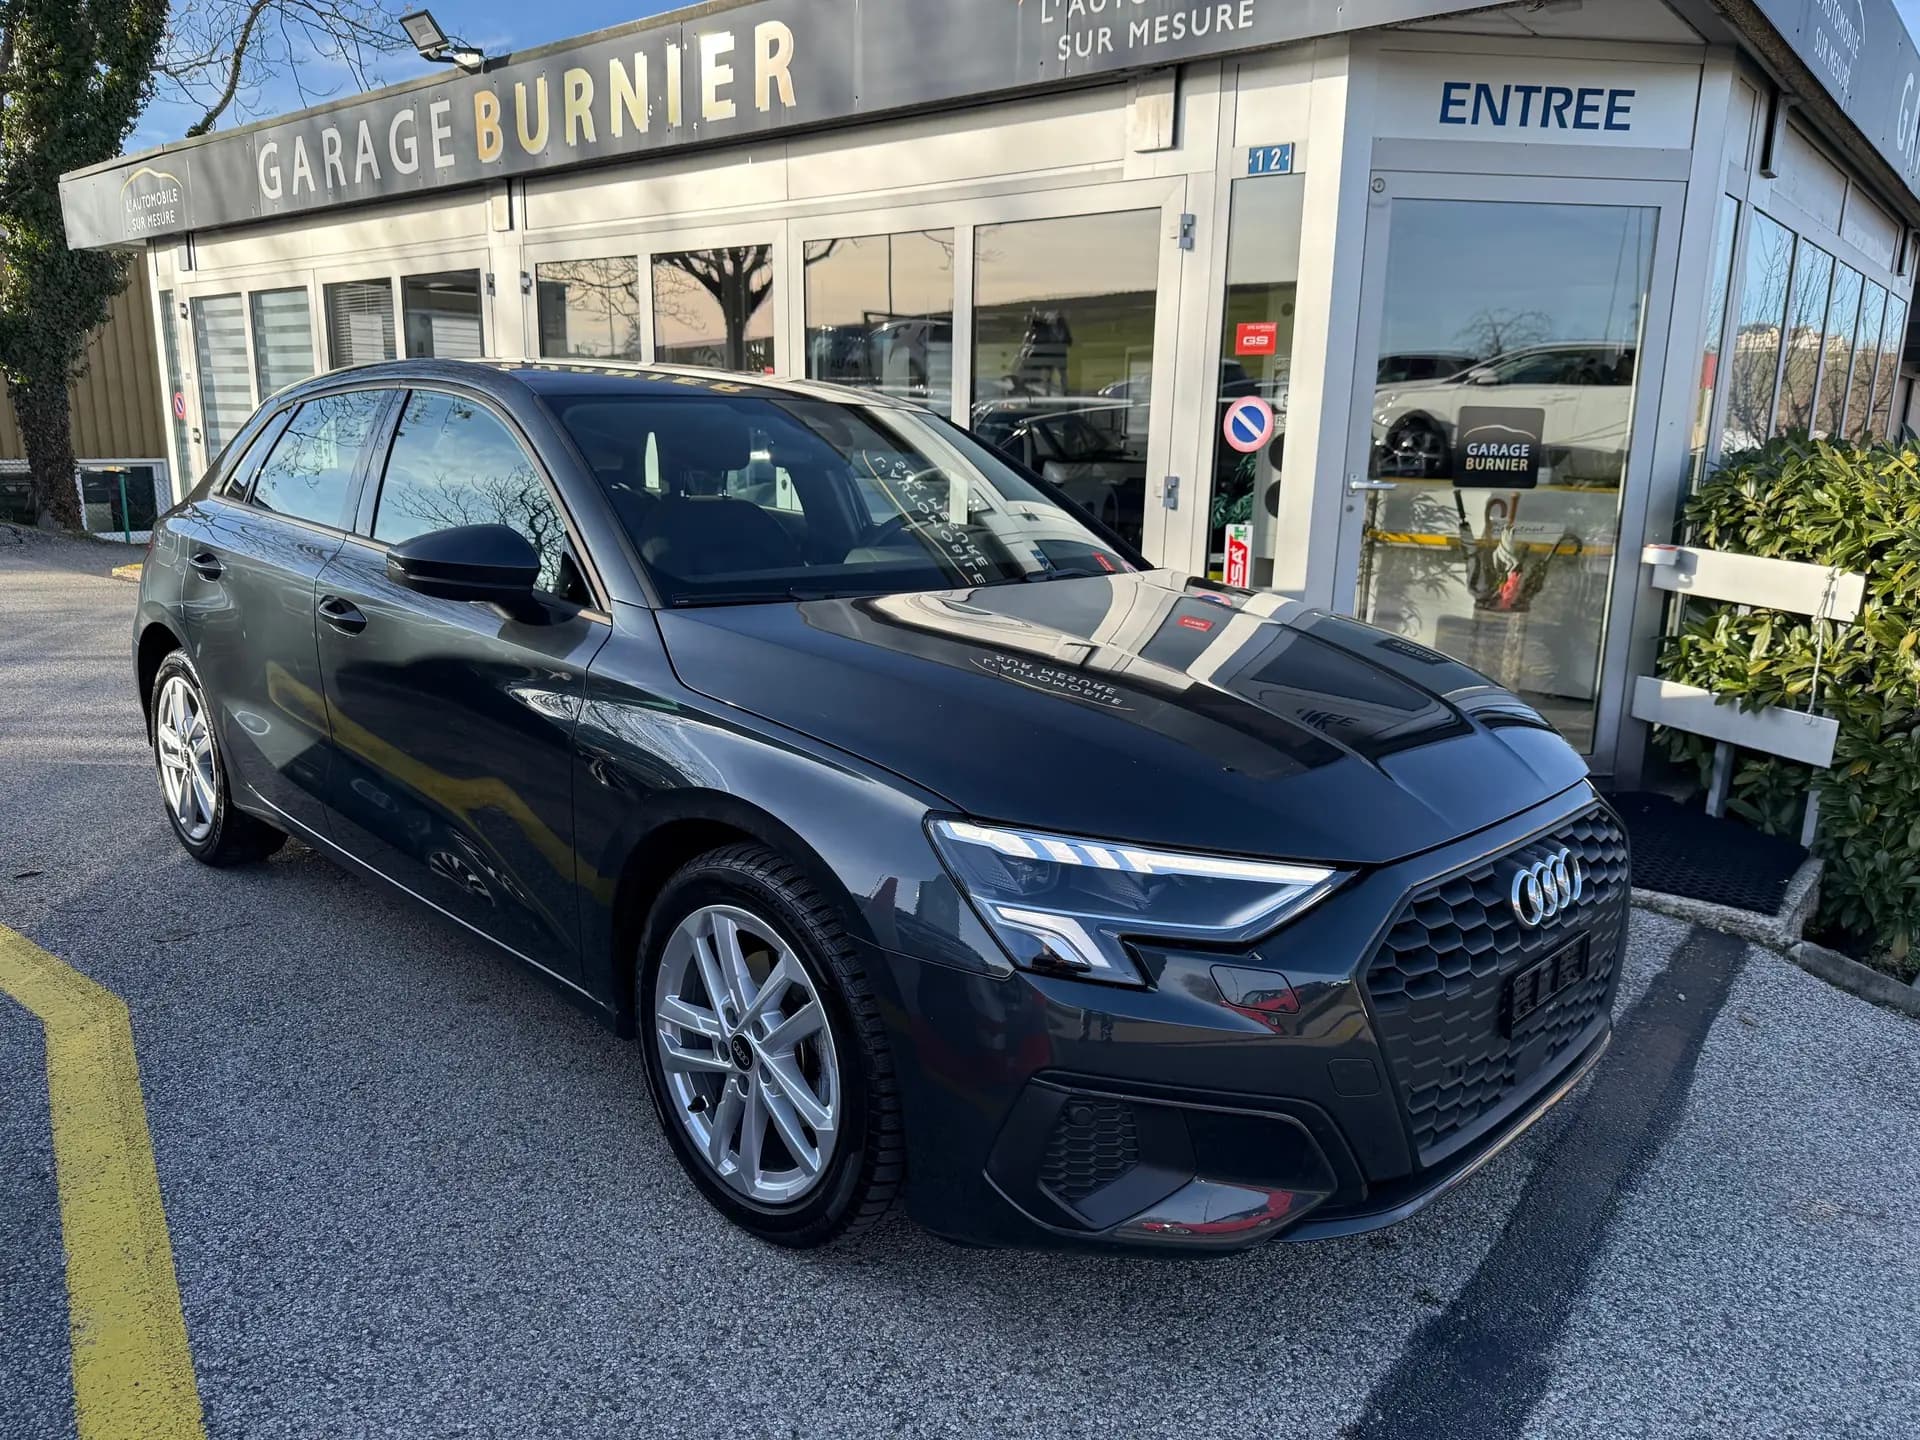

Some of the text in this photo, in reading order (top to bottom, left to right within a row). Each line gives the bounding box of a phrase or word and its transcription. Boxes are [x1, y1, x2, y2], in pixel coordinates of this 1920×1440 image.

[1058, 1, 1254, 60] SUR MESURE
[1814, 27, 1851, 93] SUR MESURE
[258, 20, 797, 200] GARAGE BURNIER
[1439, 82, 1636, 131] ENTREE
[1256, 148, 1281, 171] 12
[126, 188, 178, 212] L'AUTOMOBILE
[131, 209, 175, 232] SUR MESURE
[1467, 442, 1530, 456] GARAGE
[1465, 457, 1528, 471] BURNIER
